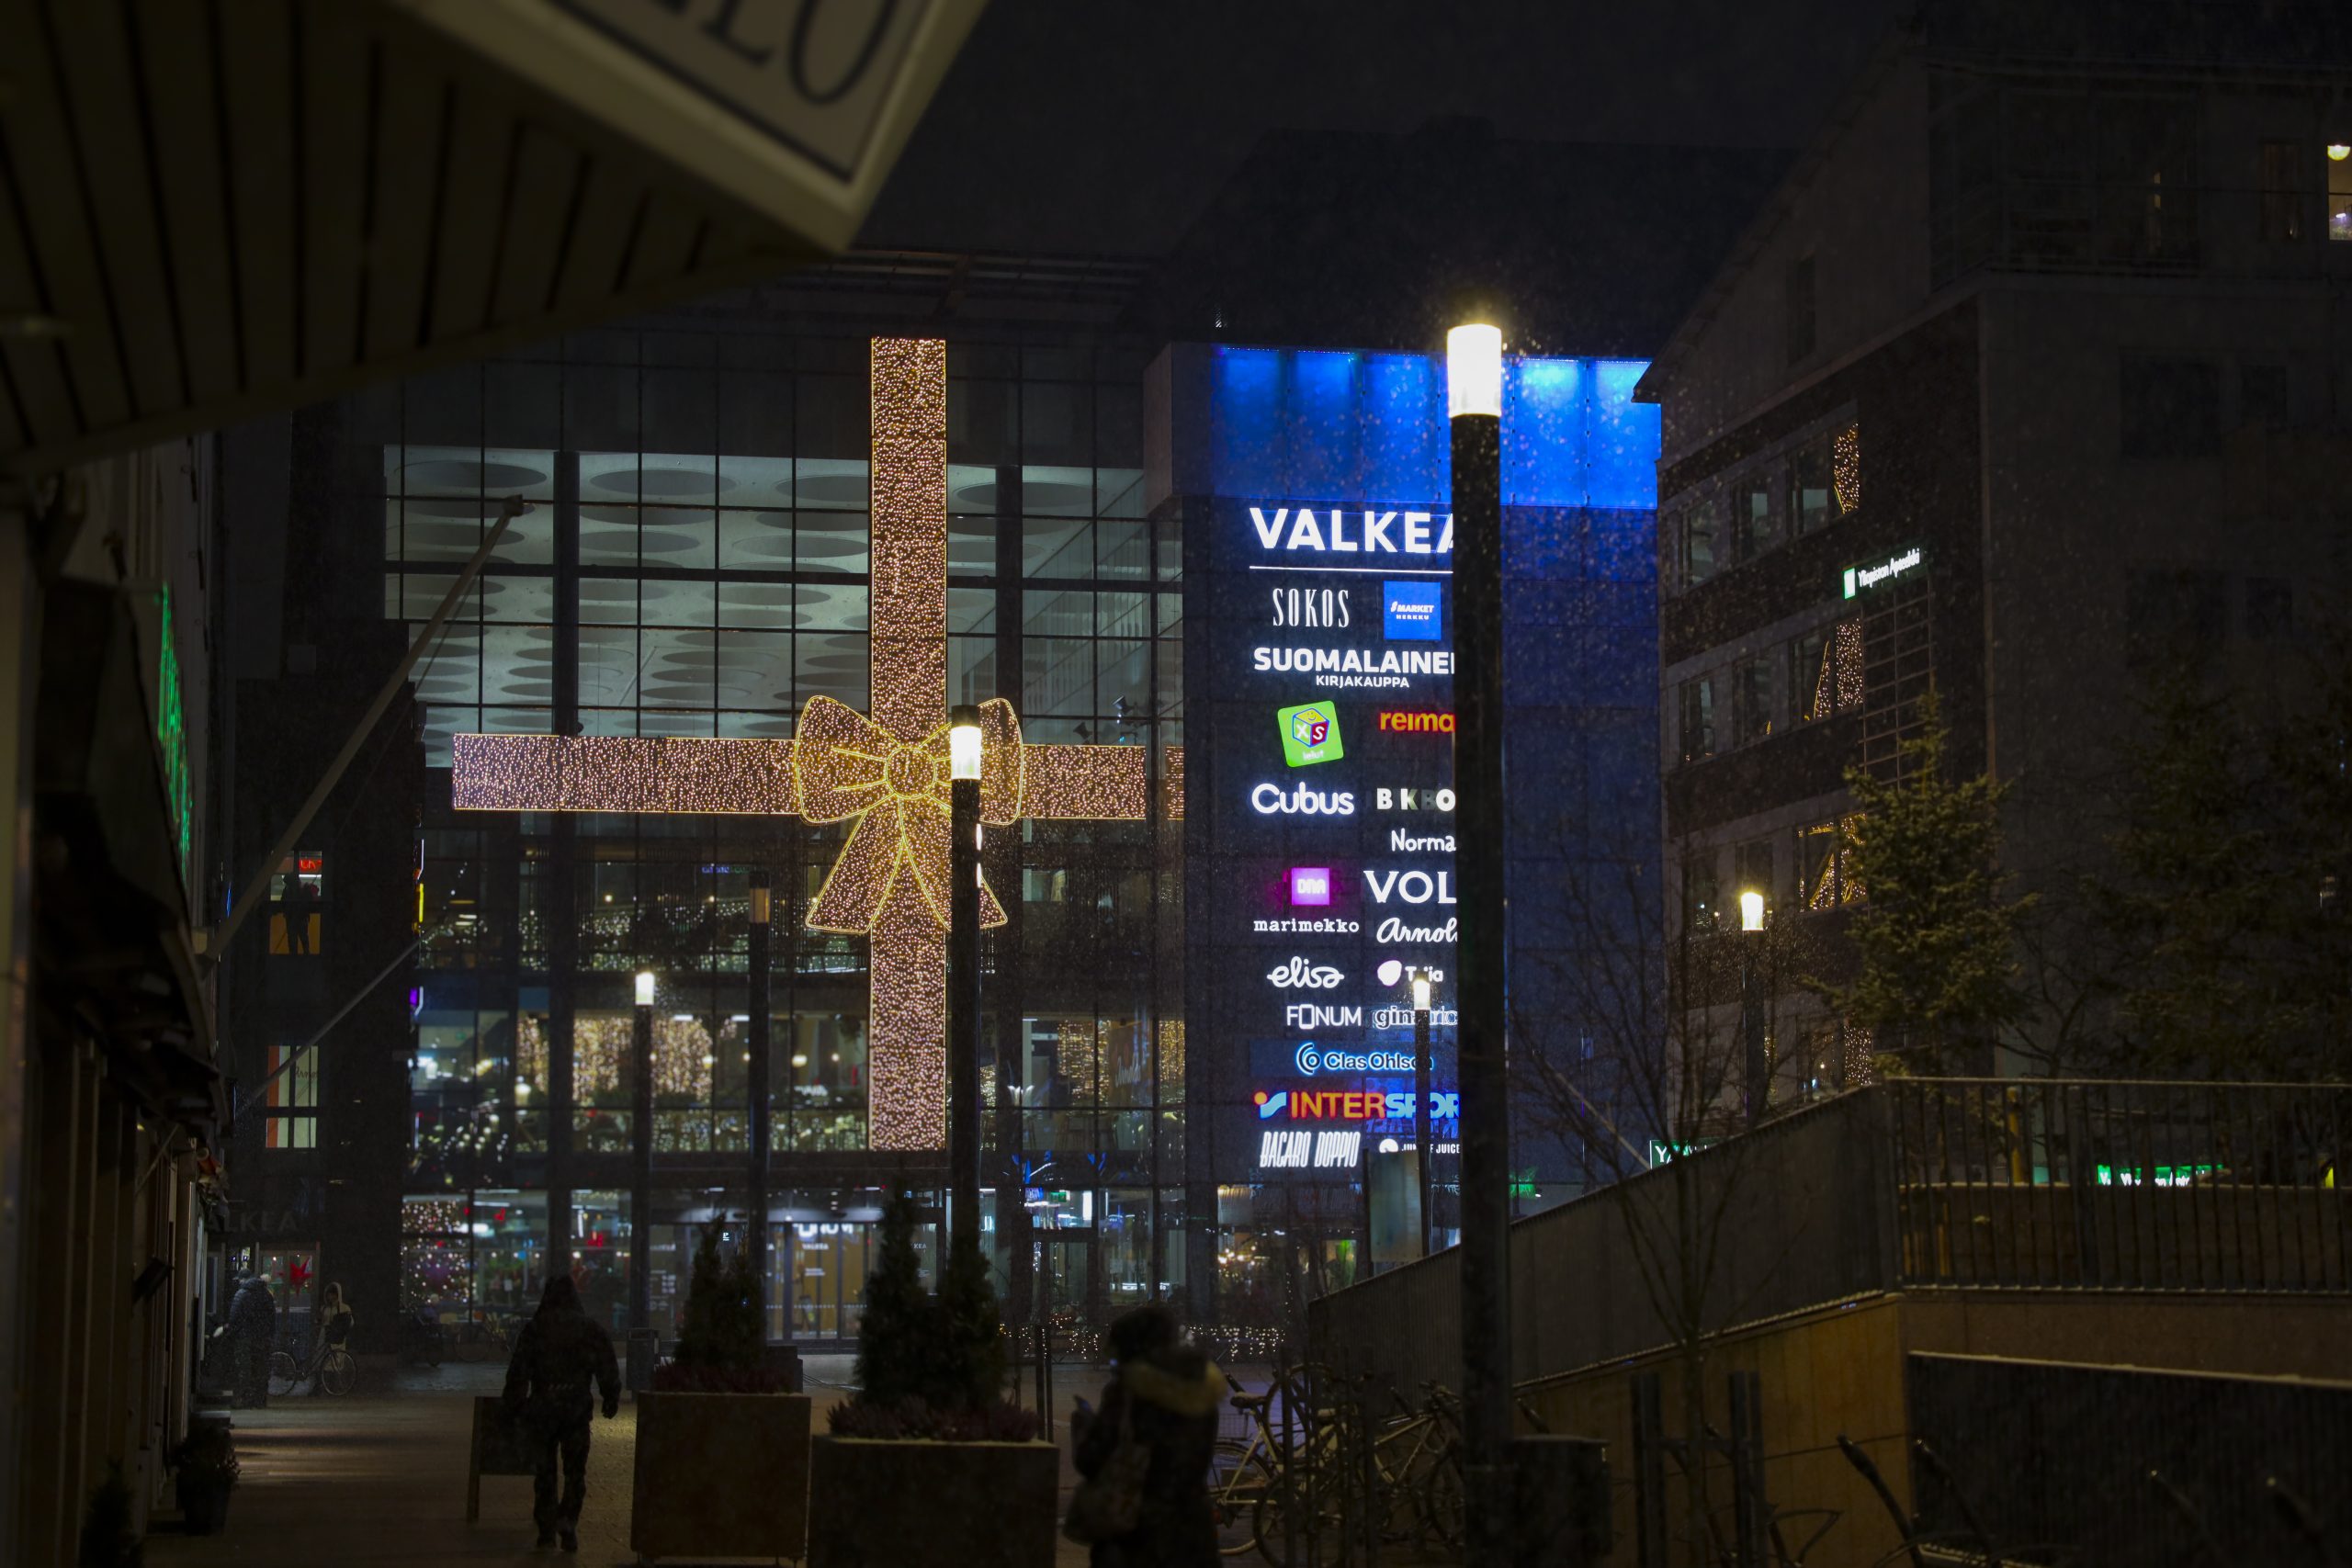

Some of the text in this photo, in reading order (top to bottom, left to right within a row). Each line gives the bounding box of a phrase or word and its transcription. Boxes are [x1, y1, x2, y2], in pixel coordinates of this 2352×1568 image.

[1272, 588, 1350, 628] SOKOS
[1316, 674, 1410, 689] KIRJAKAUPPA
[1380, 712, 1455, 733] reima
[1251, 781, 1355, 816] Cubus
[1297, 878, 1327, 895] DNA
[1253, 918, 1360, 933] marimekko
[1375, 917, 1458, 943] Arnol
[1266, 955, 1345, 989] elisa
[1286, 1003, 1363, 1030] FONUM
[1324, 1053, 1367, 1071] Clas
[1259, 1131, 1362, 1168] BACARO DOPPIO
